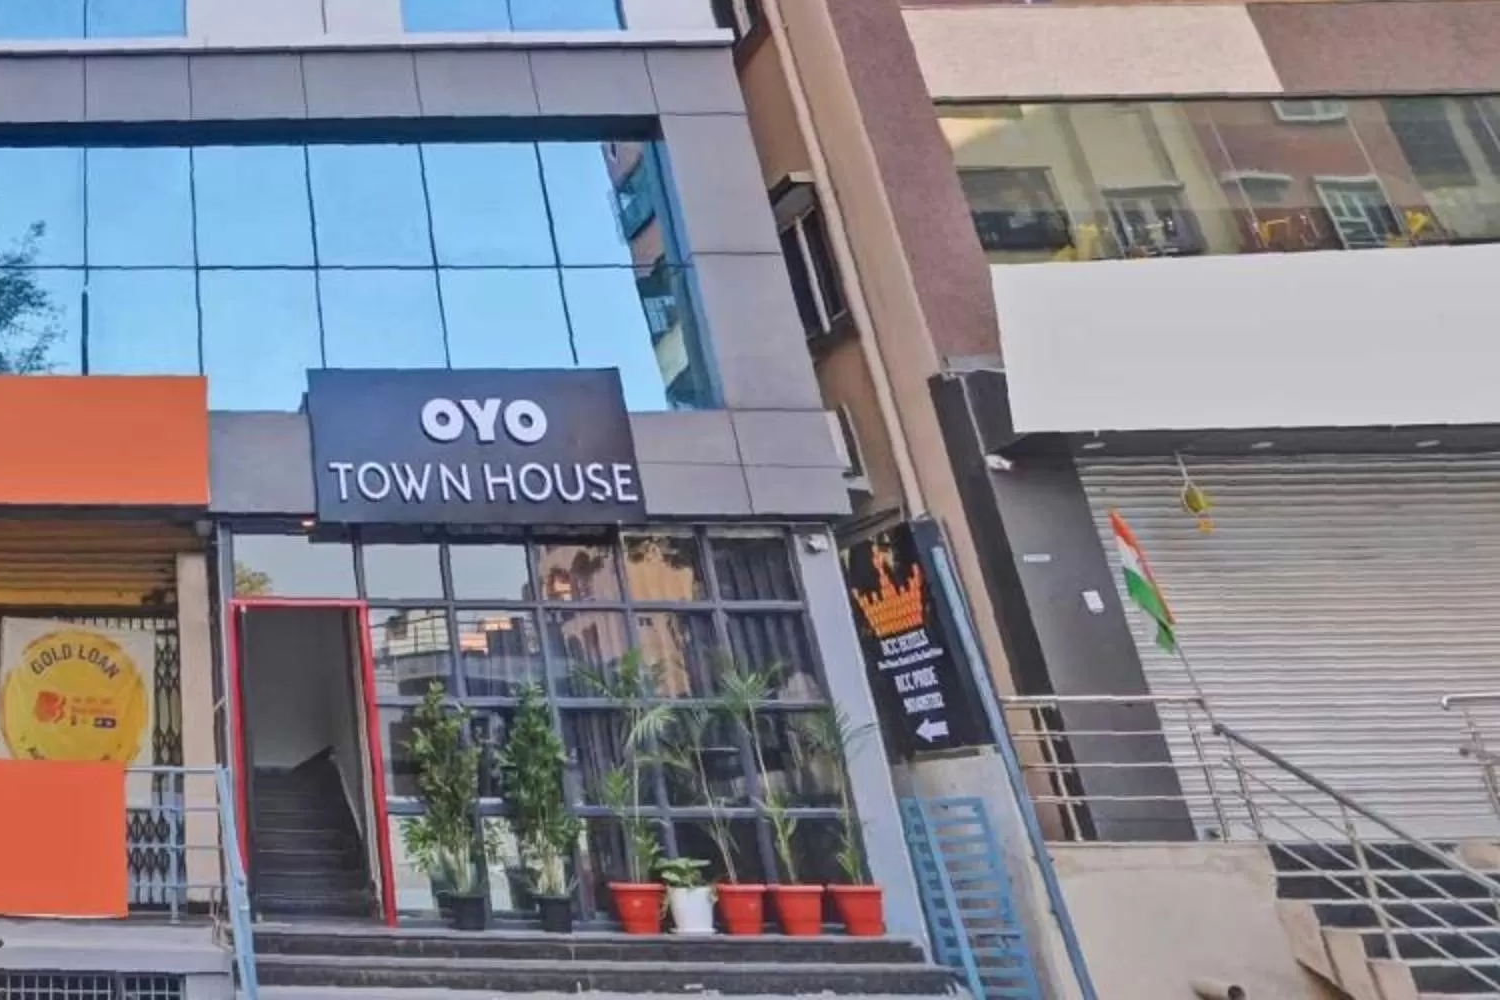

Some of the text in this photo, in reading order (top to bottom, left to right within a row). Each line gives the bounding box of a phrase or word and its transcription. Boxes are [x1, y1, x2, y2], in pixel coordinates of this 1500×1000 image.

[421, 398, 548, 443] OYO
[328, 461, 639, 503] TOWN HOUSE
[30, 643, 120, 680] GOLD LOAN
